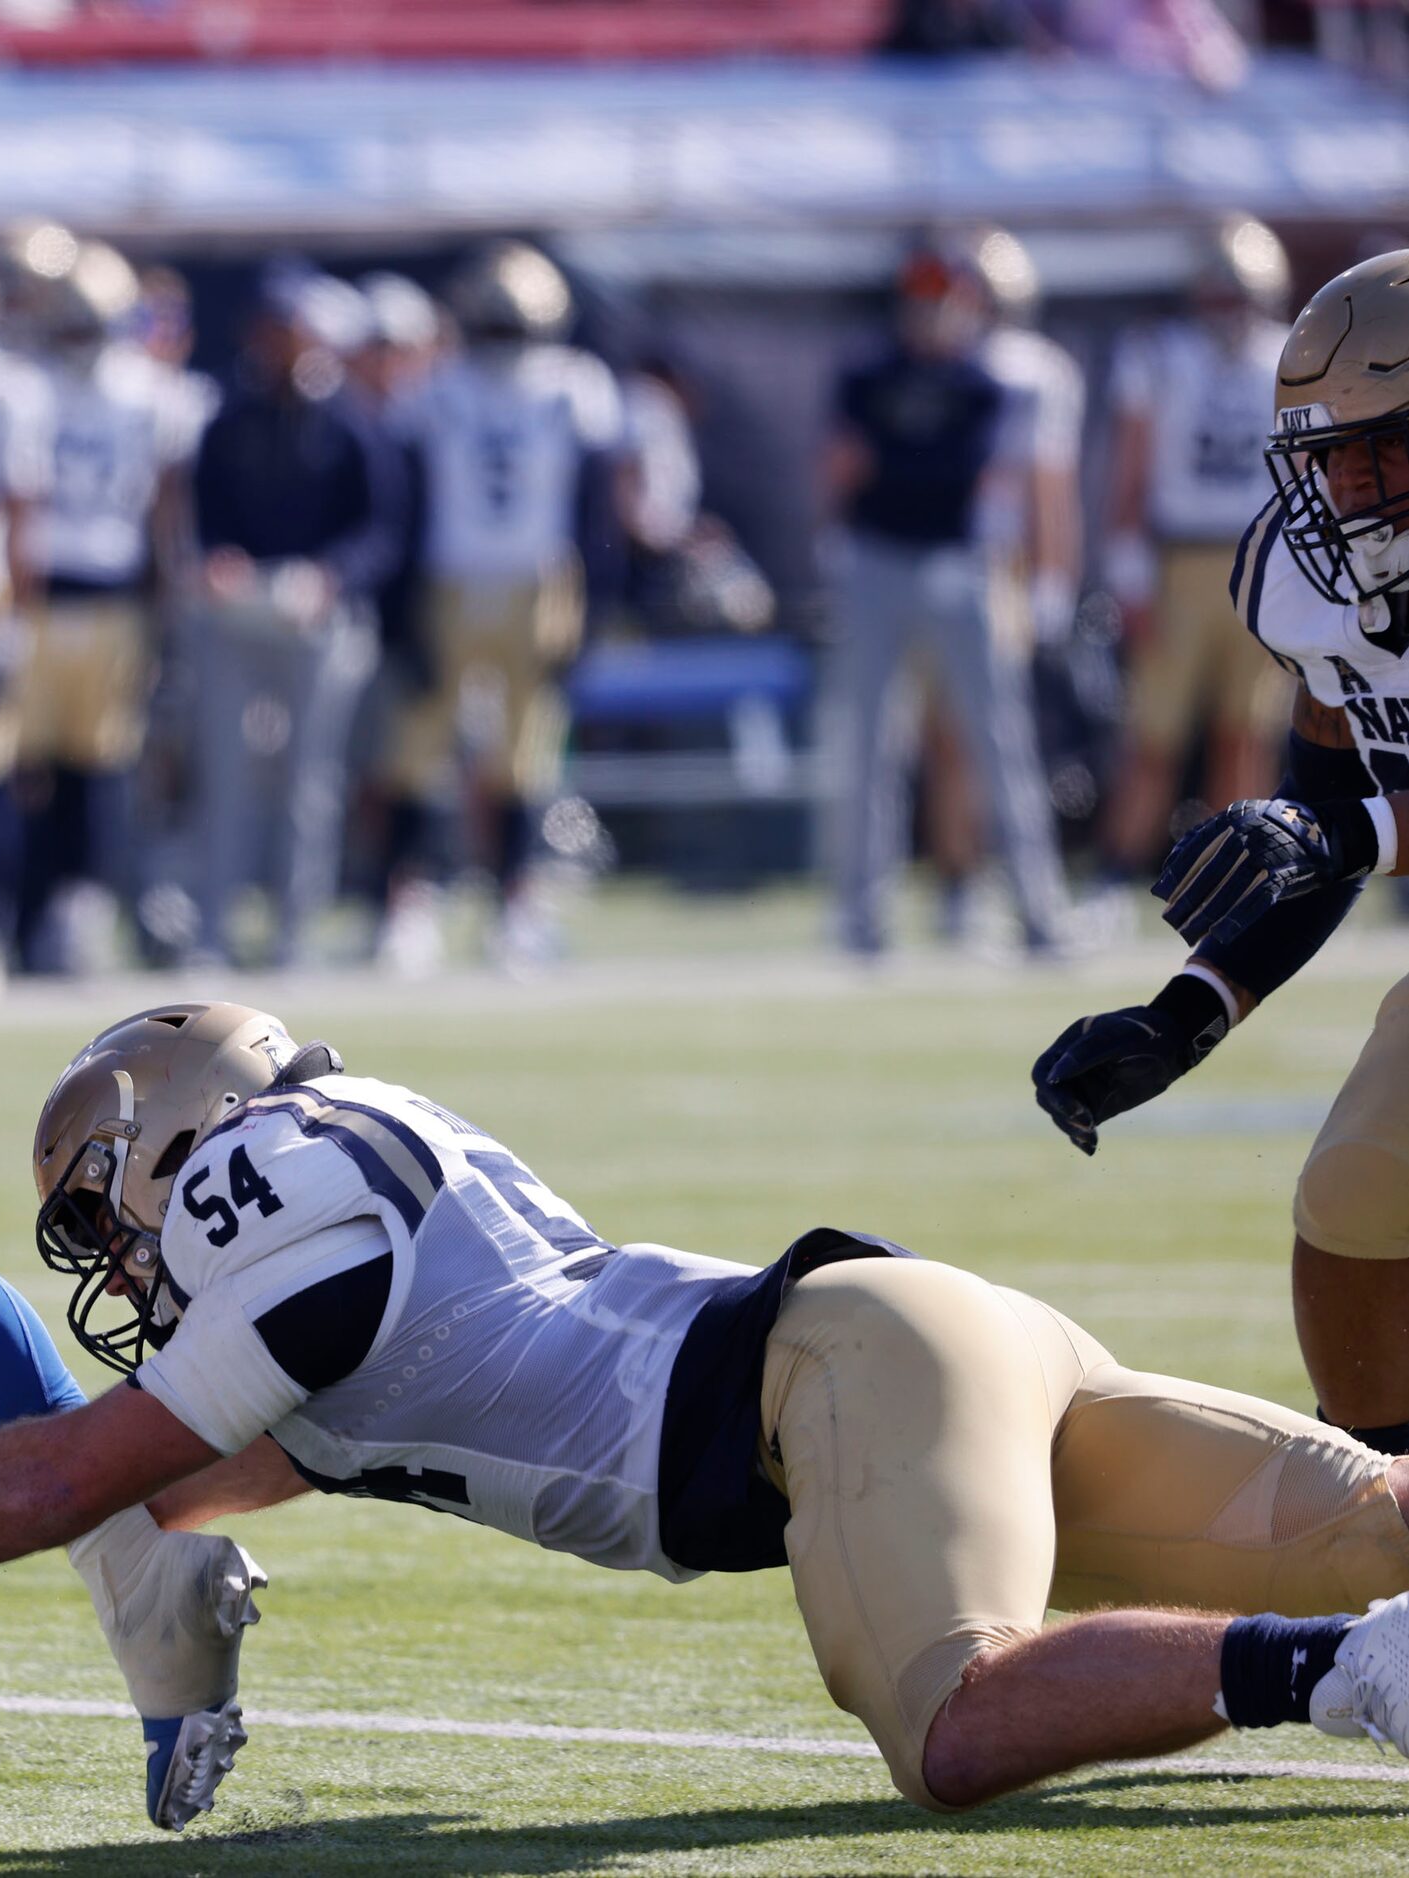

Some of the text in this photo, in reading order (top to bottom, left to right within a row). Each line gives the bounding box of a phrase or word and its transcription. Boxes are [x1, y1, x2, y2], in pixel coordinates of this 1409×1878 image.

[1281, 407, 1312, 433] NAVY
[1345, 697, 1409, 745] NA
[182, 1143, 284, 1248] 54
